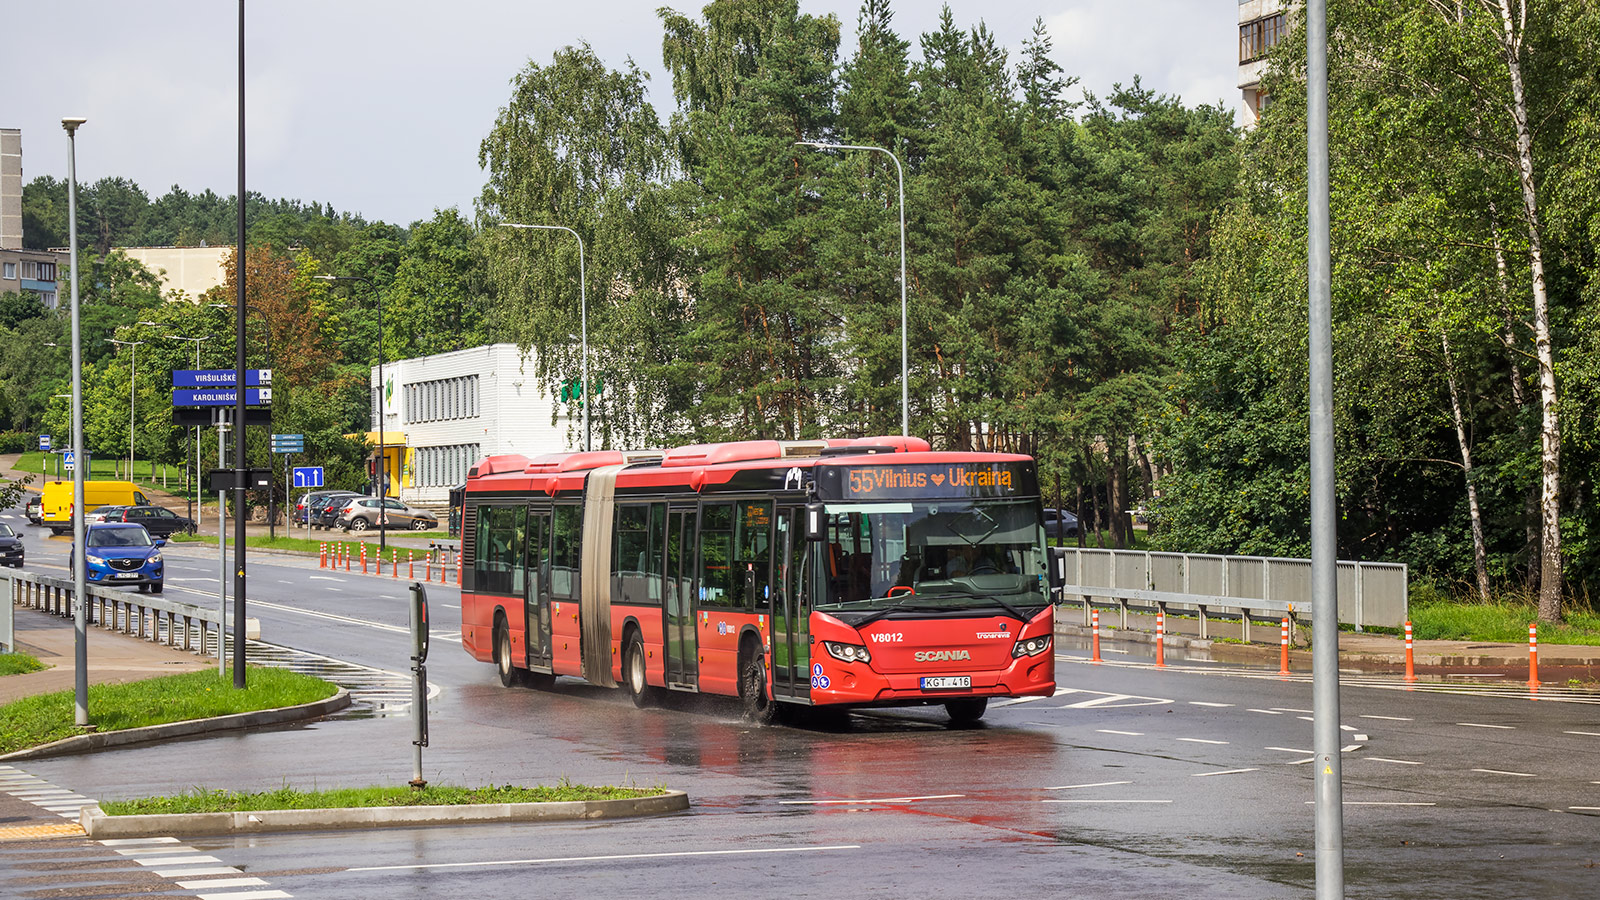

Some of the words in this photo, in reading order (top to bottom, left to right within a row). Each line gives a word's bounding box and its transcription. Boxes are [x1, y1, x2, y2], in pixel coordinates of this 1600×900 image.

[195, 373, 236, 382] VIRŠULIŠKĖ
[193, 393, 237, 401] KAROLINIŠK
[850, 470, 873, 493] 55
[873, 469, 927, 489] Vilnius
[948, 467, 1012, 489] Ukrainą
[871, 632, 904, 643] V8012
[914, 650, 972, 663] SCANIA
[926, 678, 946, 687] KGT
[952, 677, 970, 687] 416
